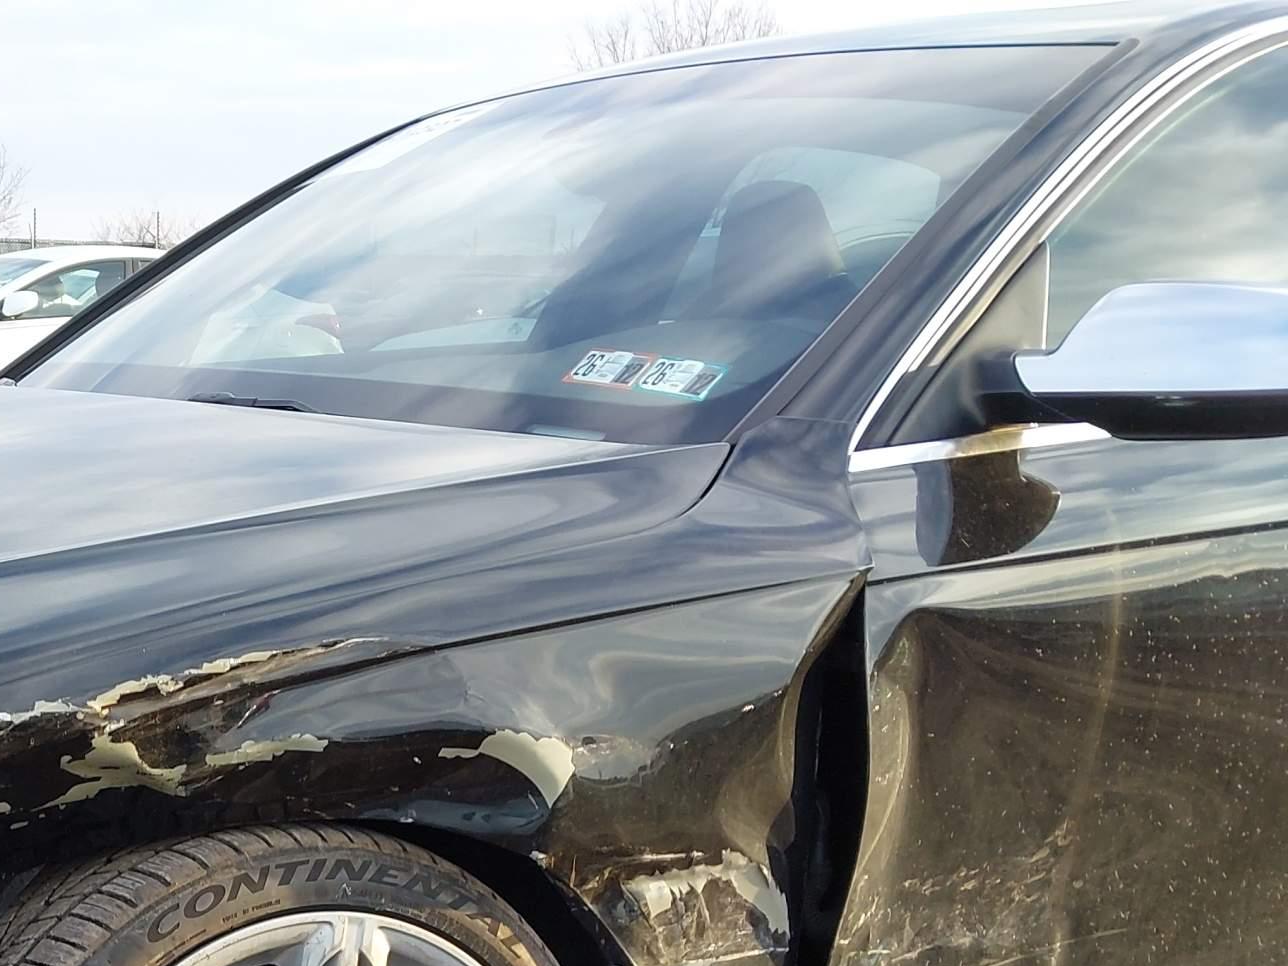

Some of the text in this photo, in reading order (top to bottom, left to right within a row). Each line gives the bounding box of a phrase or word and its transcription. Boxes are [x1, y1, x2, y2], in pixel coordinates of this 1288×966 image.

[572, 353, 645, 384] 26 12
[642, 361, 718, 396] 26 12
[147, 858, 522, 959] CONTINENTAL
